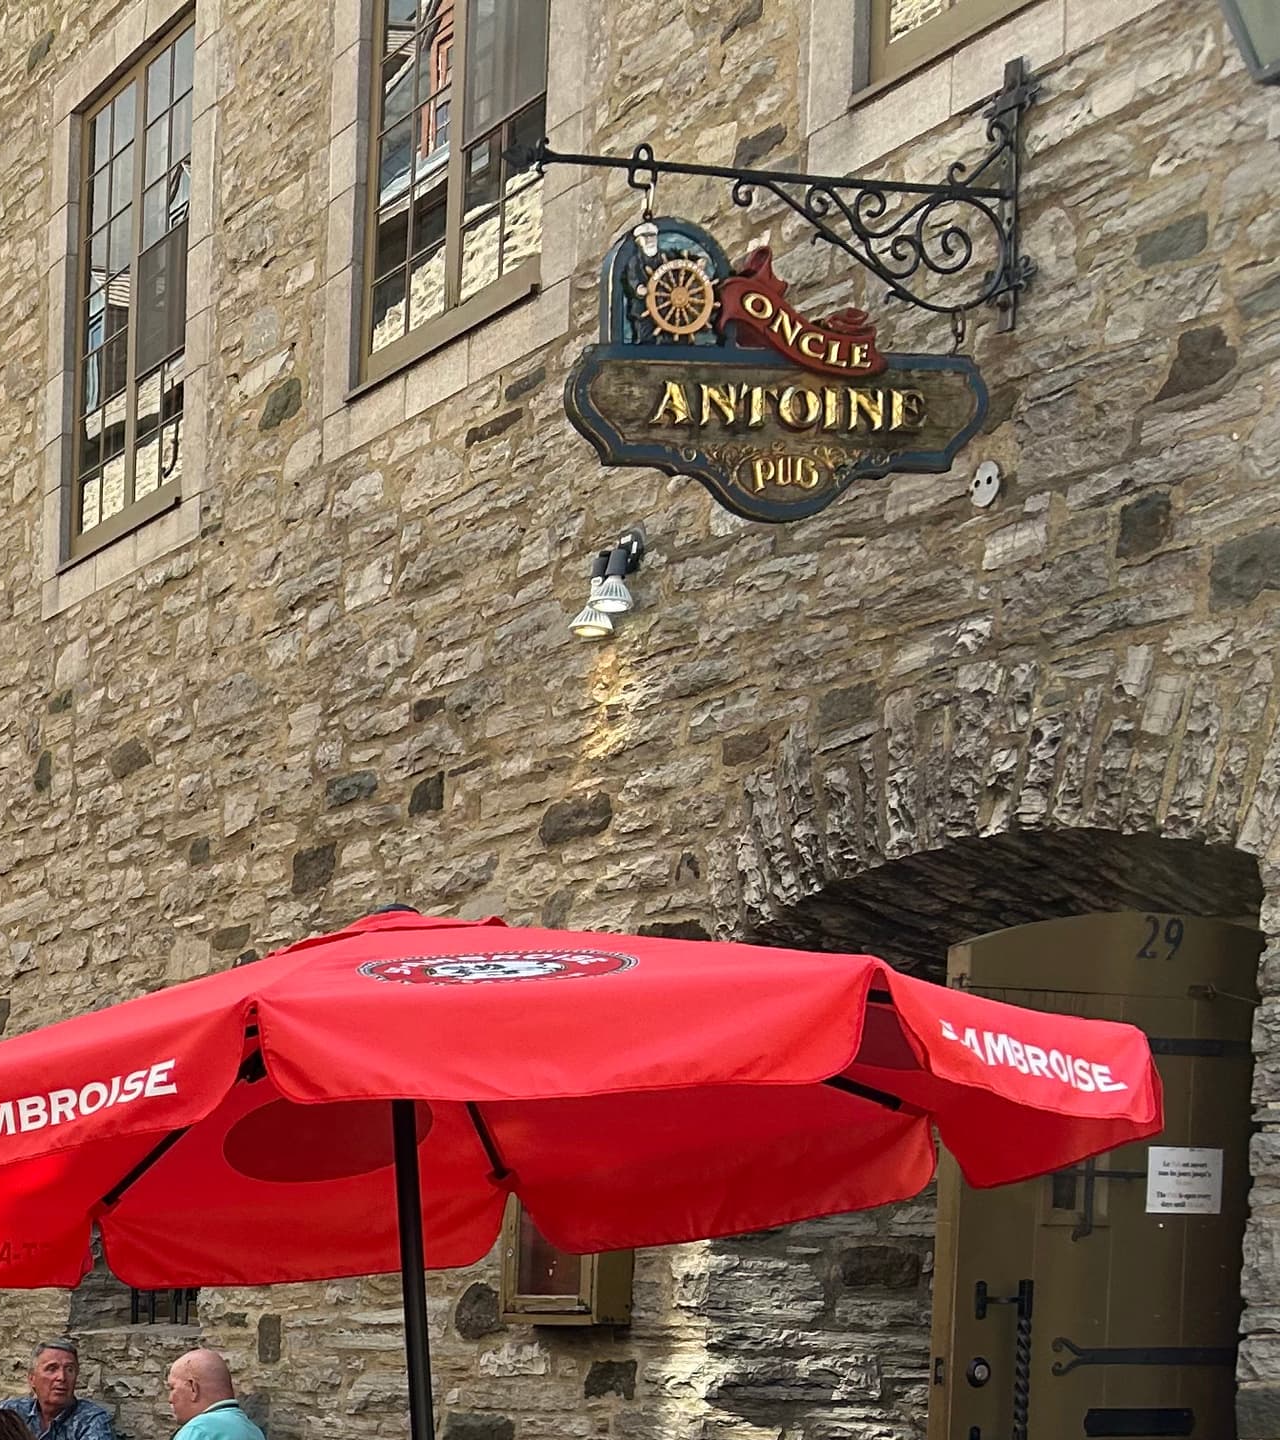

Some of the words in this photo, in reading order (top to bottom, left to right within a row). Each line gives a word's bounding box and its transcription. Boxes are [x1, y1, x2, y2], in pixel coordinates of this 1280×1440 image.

[742, 290, 873, 370] ONCLE
[648, 380, 930, 434] ANTOINE
[750, 455, 820, 494] PUB
[1136, 915, 1184, 960] 29
